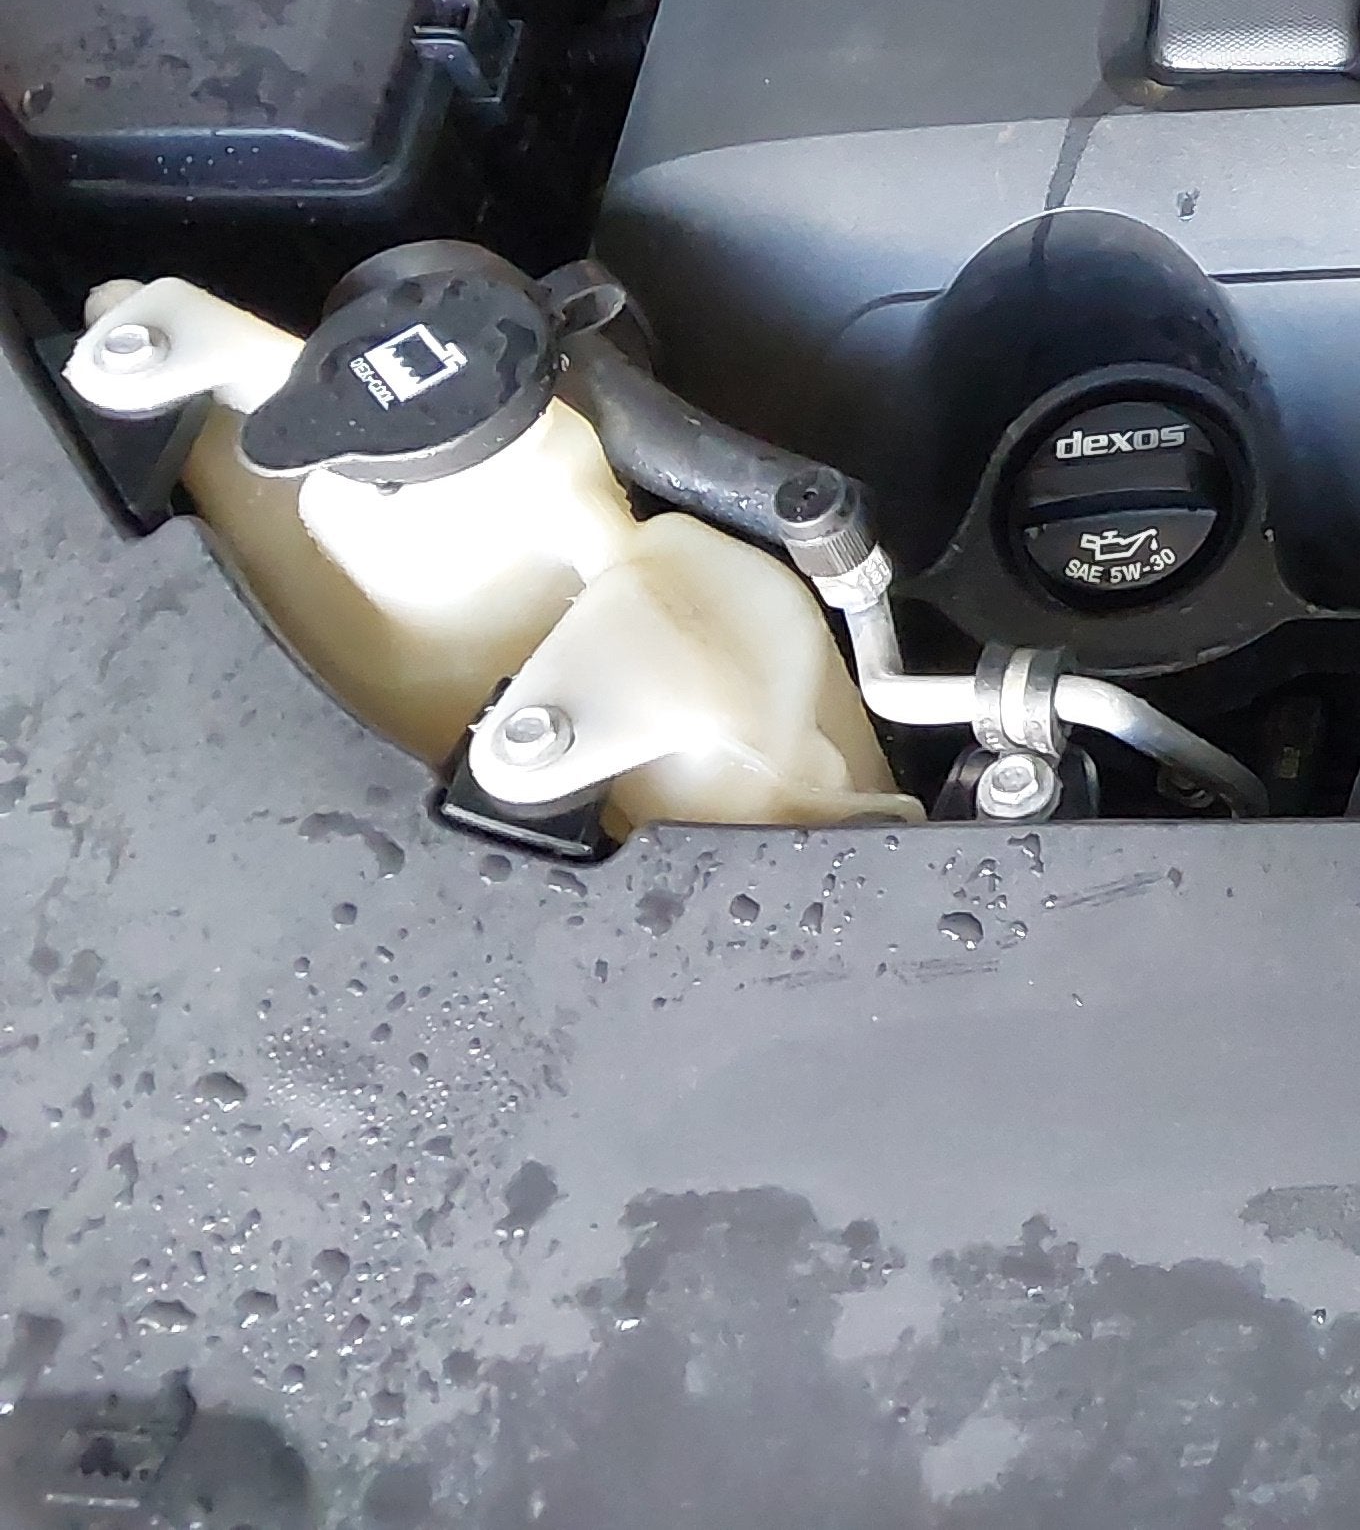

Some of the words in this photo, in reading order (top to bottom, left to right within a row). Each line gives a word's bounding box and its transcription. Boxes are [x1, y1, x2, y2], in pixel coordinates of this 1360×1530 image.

[1055, 423, 1191, 460] dexos
[1064, 559, 1104, 584] SAE
[1109, 548, 1176, 584] 5W-30
